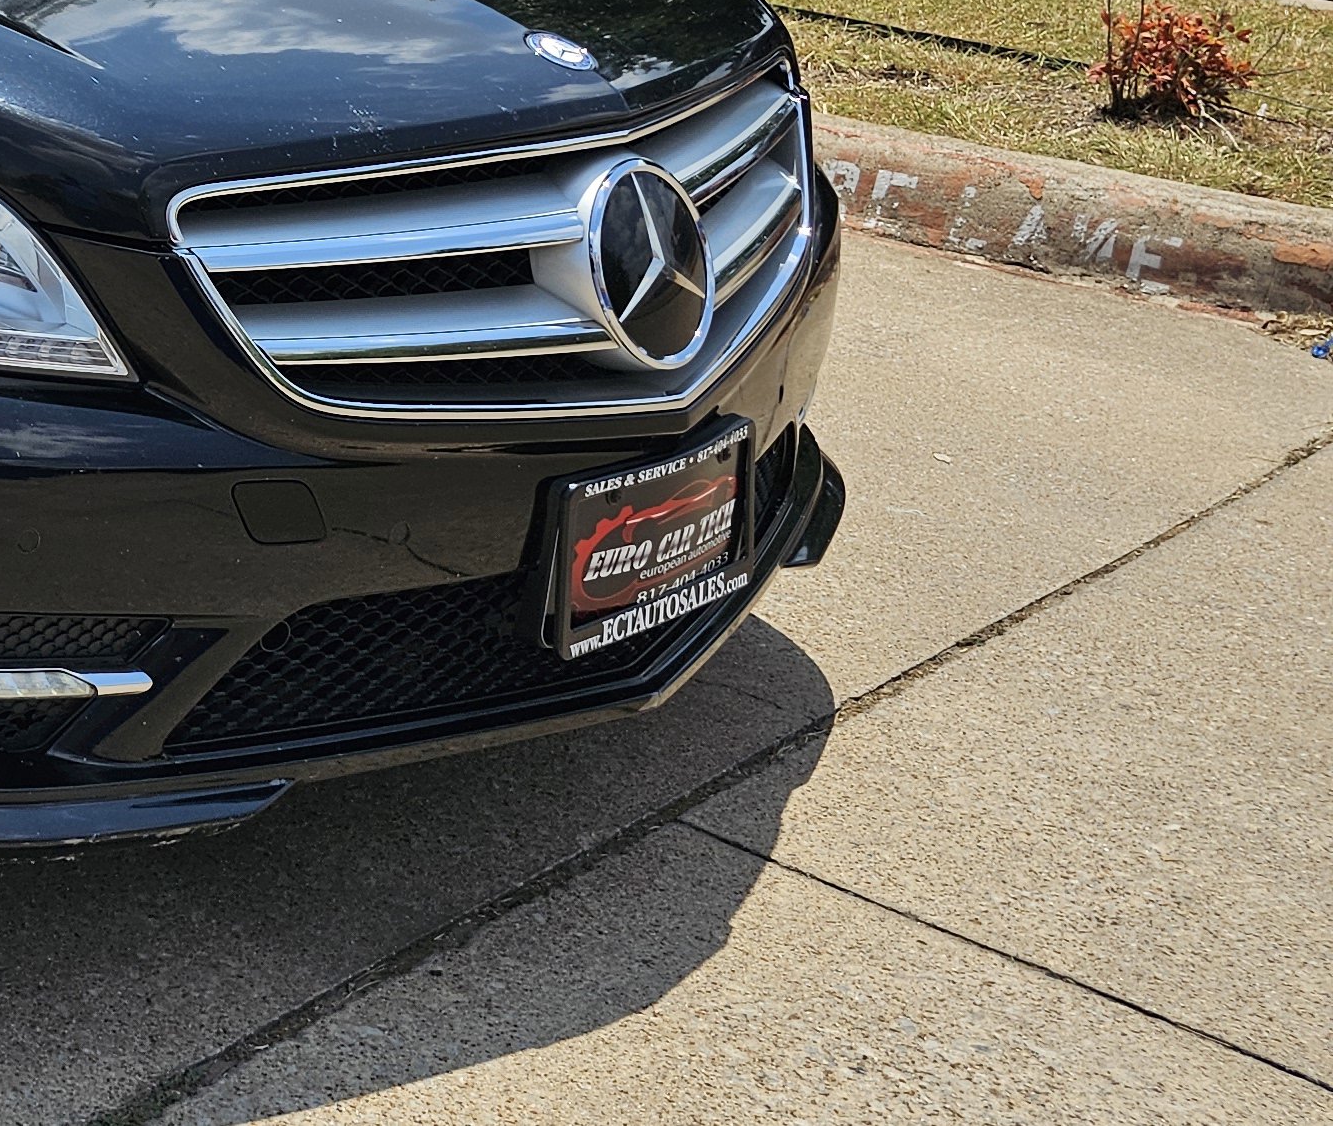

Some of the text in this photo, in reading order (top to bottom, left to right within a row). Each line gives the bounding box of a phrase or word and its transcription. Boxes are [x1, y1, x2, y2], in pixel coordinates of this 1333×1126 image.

[584, 425, 749, 498] SALES & SERVICE 817-404-4033
[583, 498, 736, 582] EURO CAR TECH
[639, 529, 732, 580] european automotive
[636, 551, 729, 603] 817-404-4033
[569, 572, 749, 659] www.ECTAUTOSALES.com
